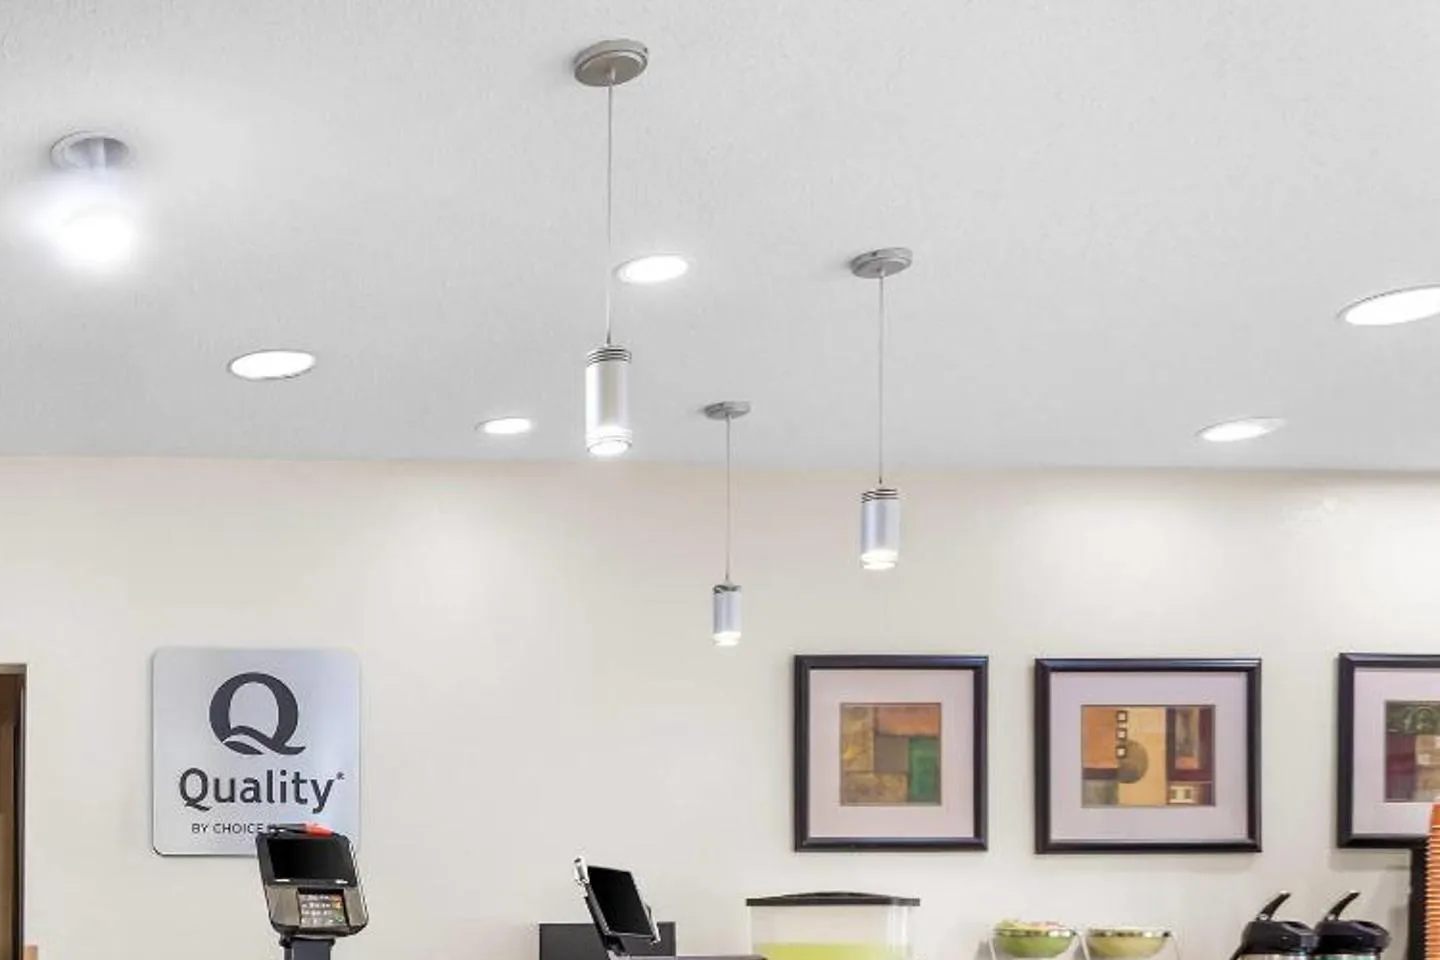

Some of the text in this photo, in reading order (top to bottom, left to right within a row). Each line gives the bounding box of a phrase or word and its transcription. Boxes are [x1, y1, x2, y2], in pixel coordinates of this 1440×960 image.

[209, 671, 306, 755] Q
[179, 767, 334, 814] Quality
[191, 823, 263, 834] BY CHOICE
